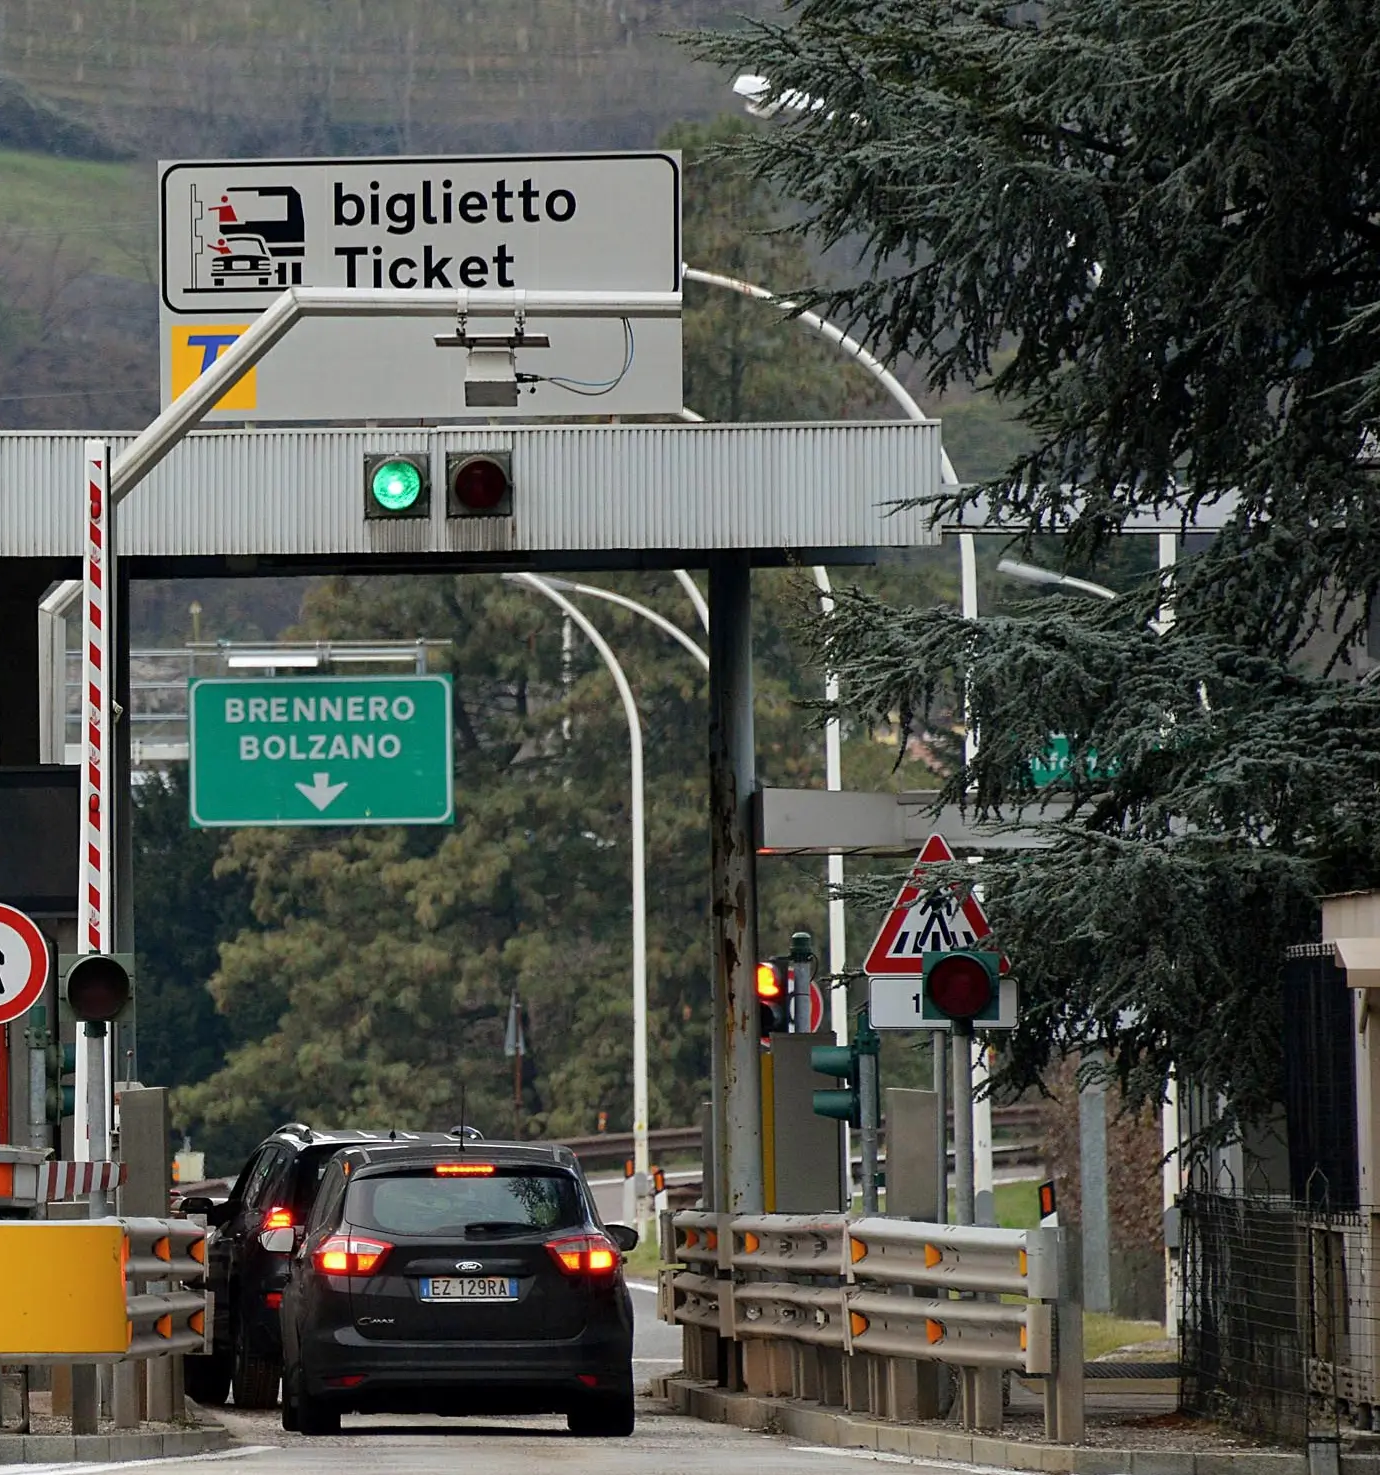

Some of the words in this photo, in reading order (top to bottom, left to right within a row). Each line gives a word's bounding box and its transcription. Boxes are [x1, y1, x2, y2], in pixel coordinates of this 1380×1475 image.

[334, 179, 576, 235] biglietto
[334, 244, 515, 288] Ticket
[225, 696, 415, 723] BRENNERO
[239, 734, 401, 760] BOLZANO
[431, 1280, 451, 1295] EZ
[459, 1280, 507, 1295] 129RA
